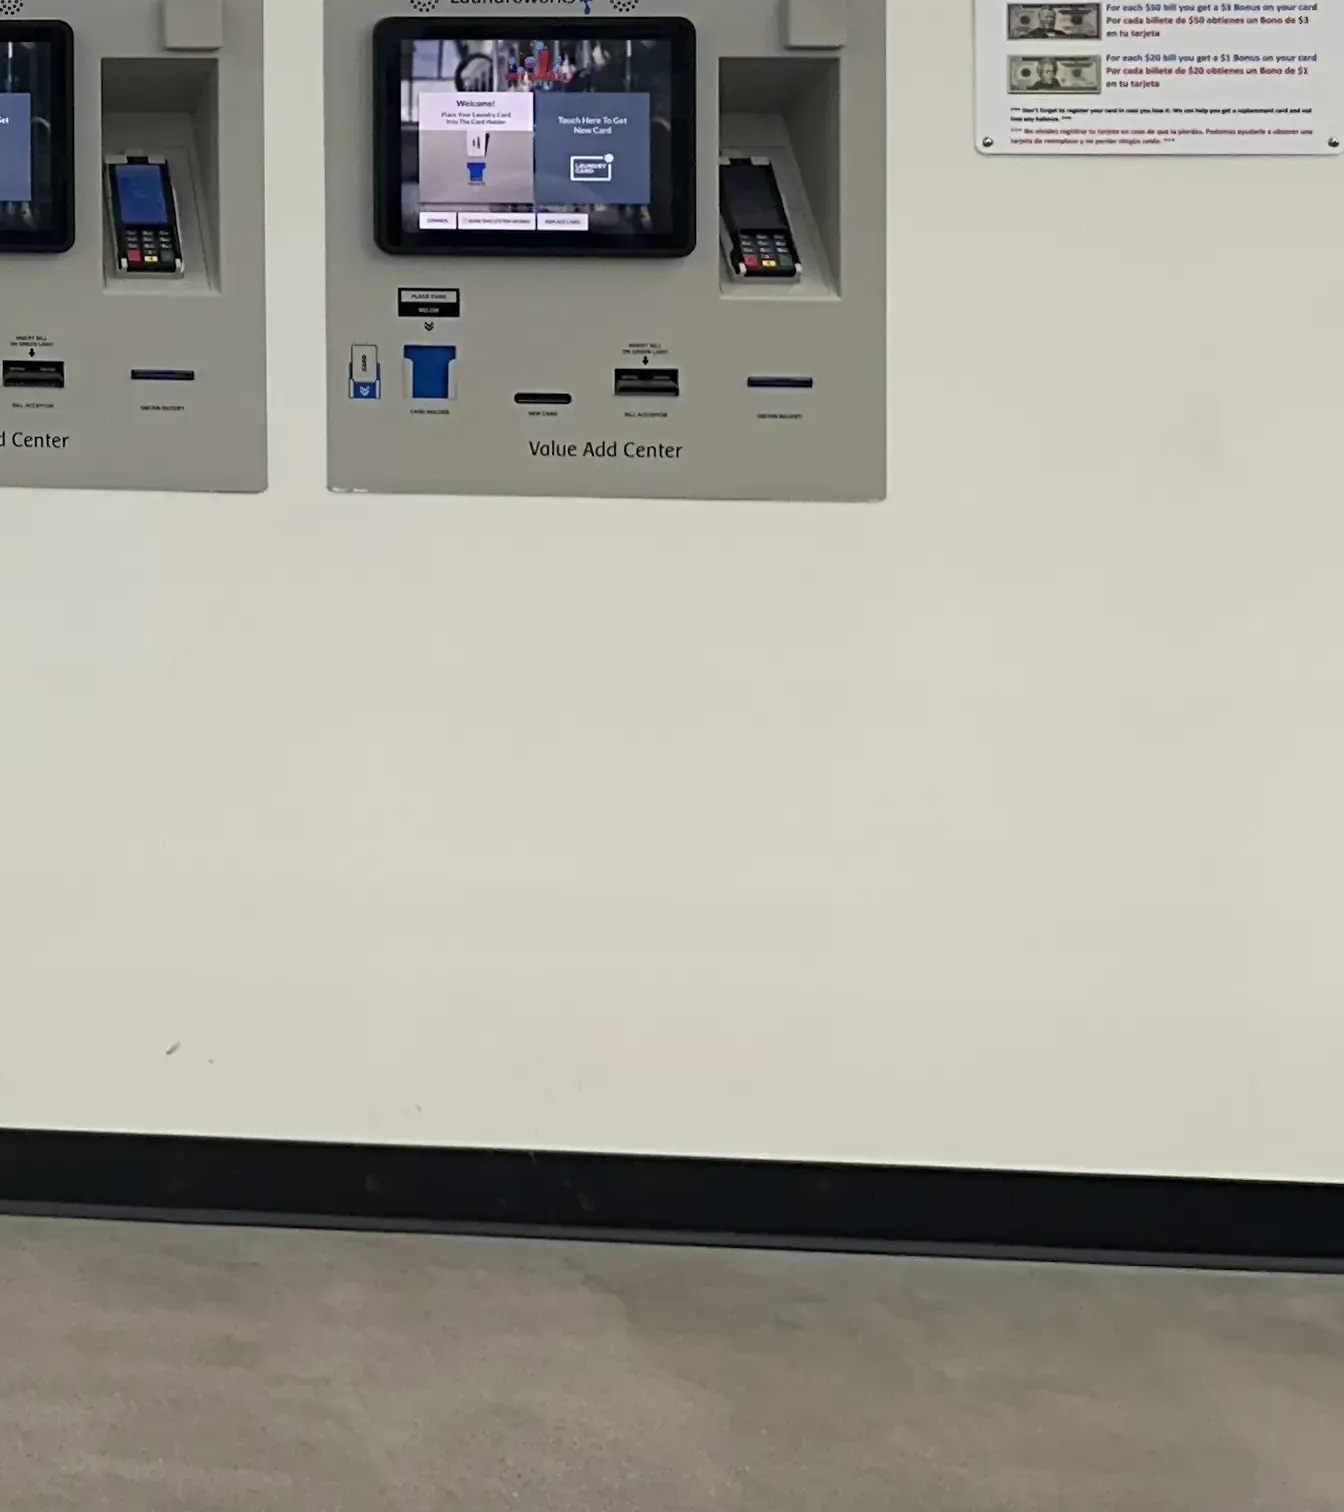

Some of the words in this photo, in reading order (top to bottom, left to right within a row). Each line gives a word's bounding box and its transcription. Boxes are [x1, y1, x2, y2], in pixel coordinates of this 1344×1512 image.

[1162, 53, 1177, 61] bill
[1196, 54, 1211, 63] get
[1232, 53, 1260, 61] Bonus
[1297, 53, 1317, 61] card
[557, 116, 582, 125] Touch
[583, 116, 601, 125] Here
[602, 116, 612, 125] To
[612, 117, 628, 126] Get
[573, 126, 591, 135] New
[592, 126, 612, 135] Card
[11, 432, 69, 448] Center
[529, 440, 576, 456] Value
[582, 440, 617, 457] Add
[623, 442, 682, 458] Center
